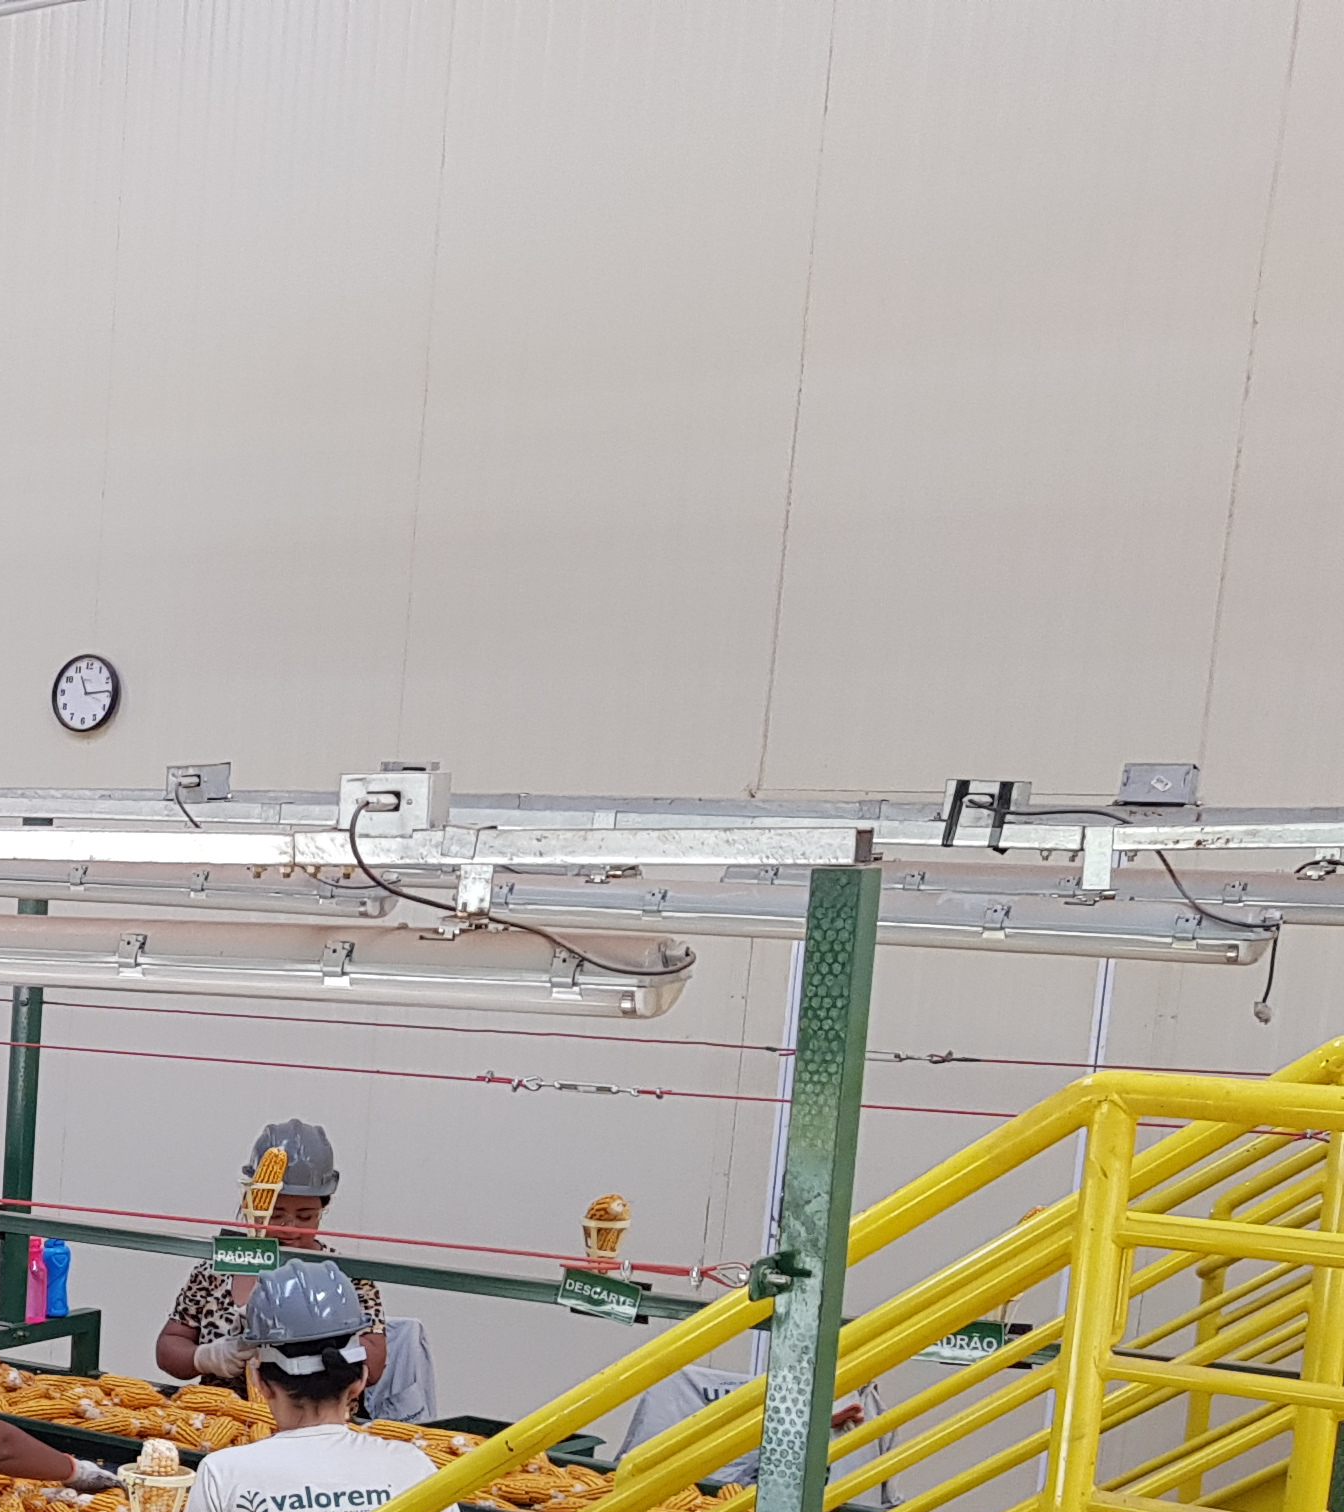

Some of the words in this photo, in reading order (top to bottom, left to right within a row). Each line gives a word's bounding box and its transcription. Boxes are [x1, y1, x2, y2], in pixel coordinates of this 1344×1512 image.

[86, 662, 94, 670] 12
[216, 1248, 274, 1265] PADRÃO
[565, 1279, 635, 1307] DESCARTE
[270, 1486, 391, 1511] valorem
